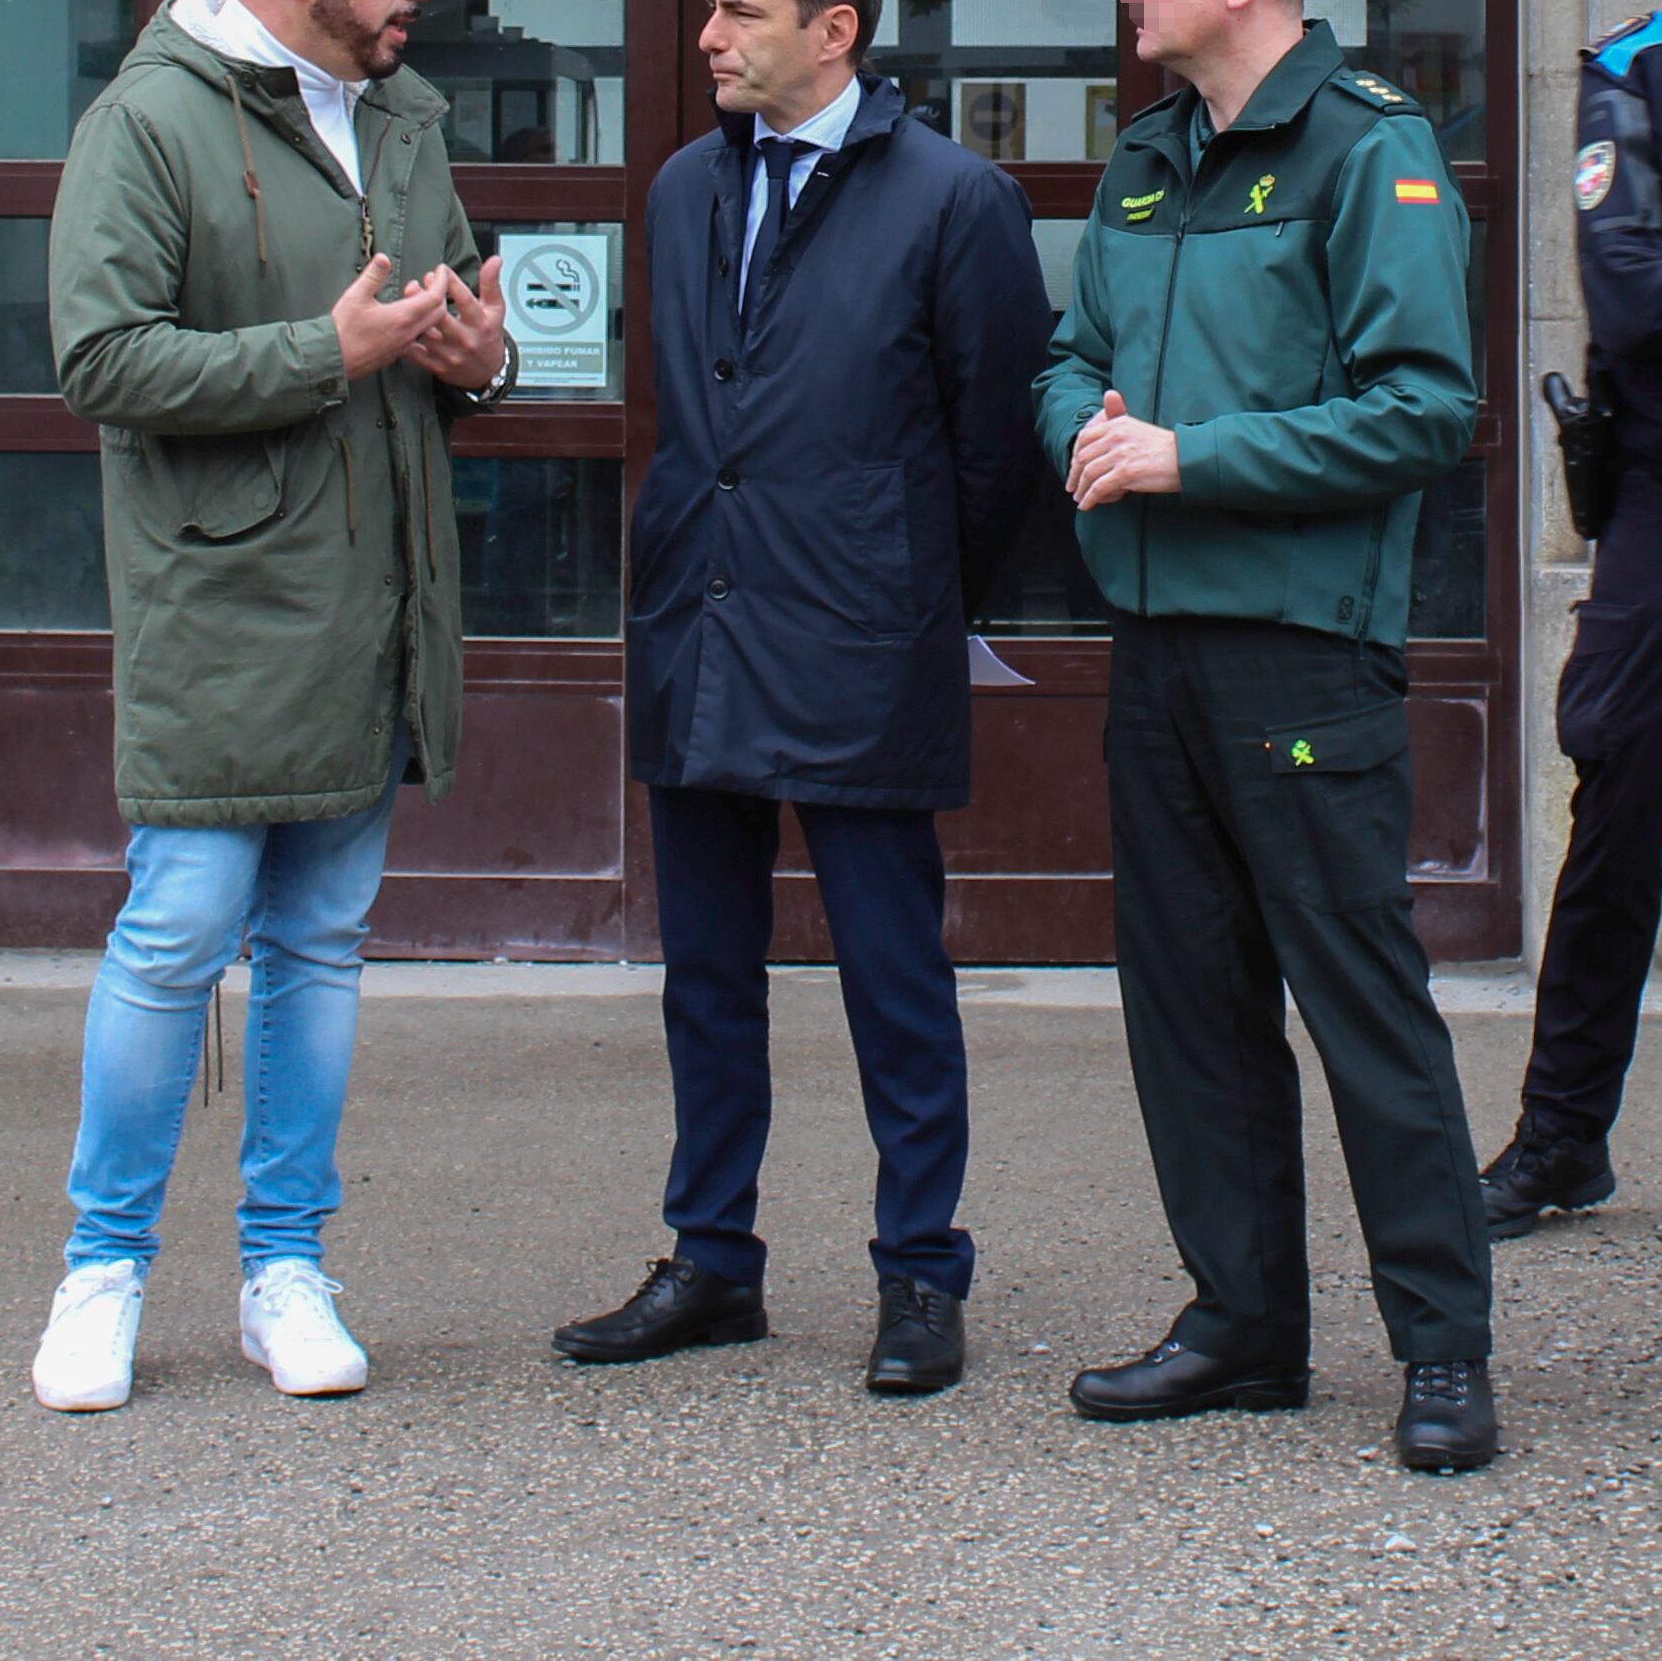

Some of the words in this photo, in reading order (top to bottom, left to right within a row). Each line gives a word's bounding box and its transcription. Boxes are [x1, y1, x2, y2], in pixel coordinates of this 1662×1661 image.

[518, 346, 562, 355] OHIBIDO
[564, 346, 600, 355] FUMAR
[537, 360, 578, 368] VAPEAR
